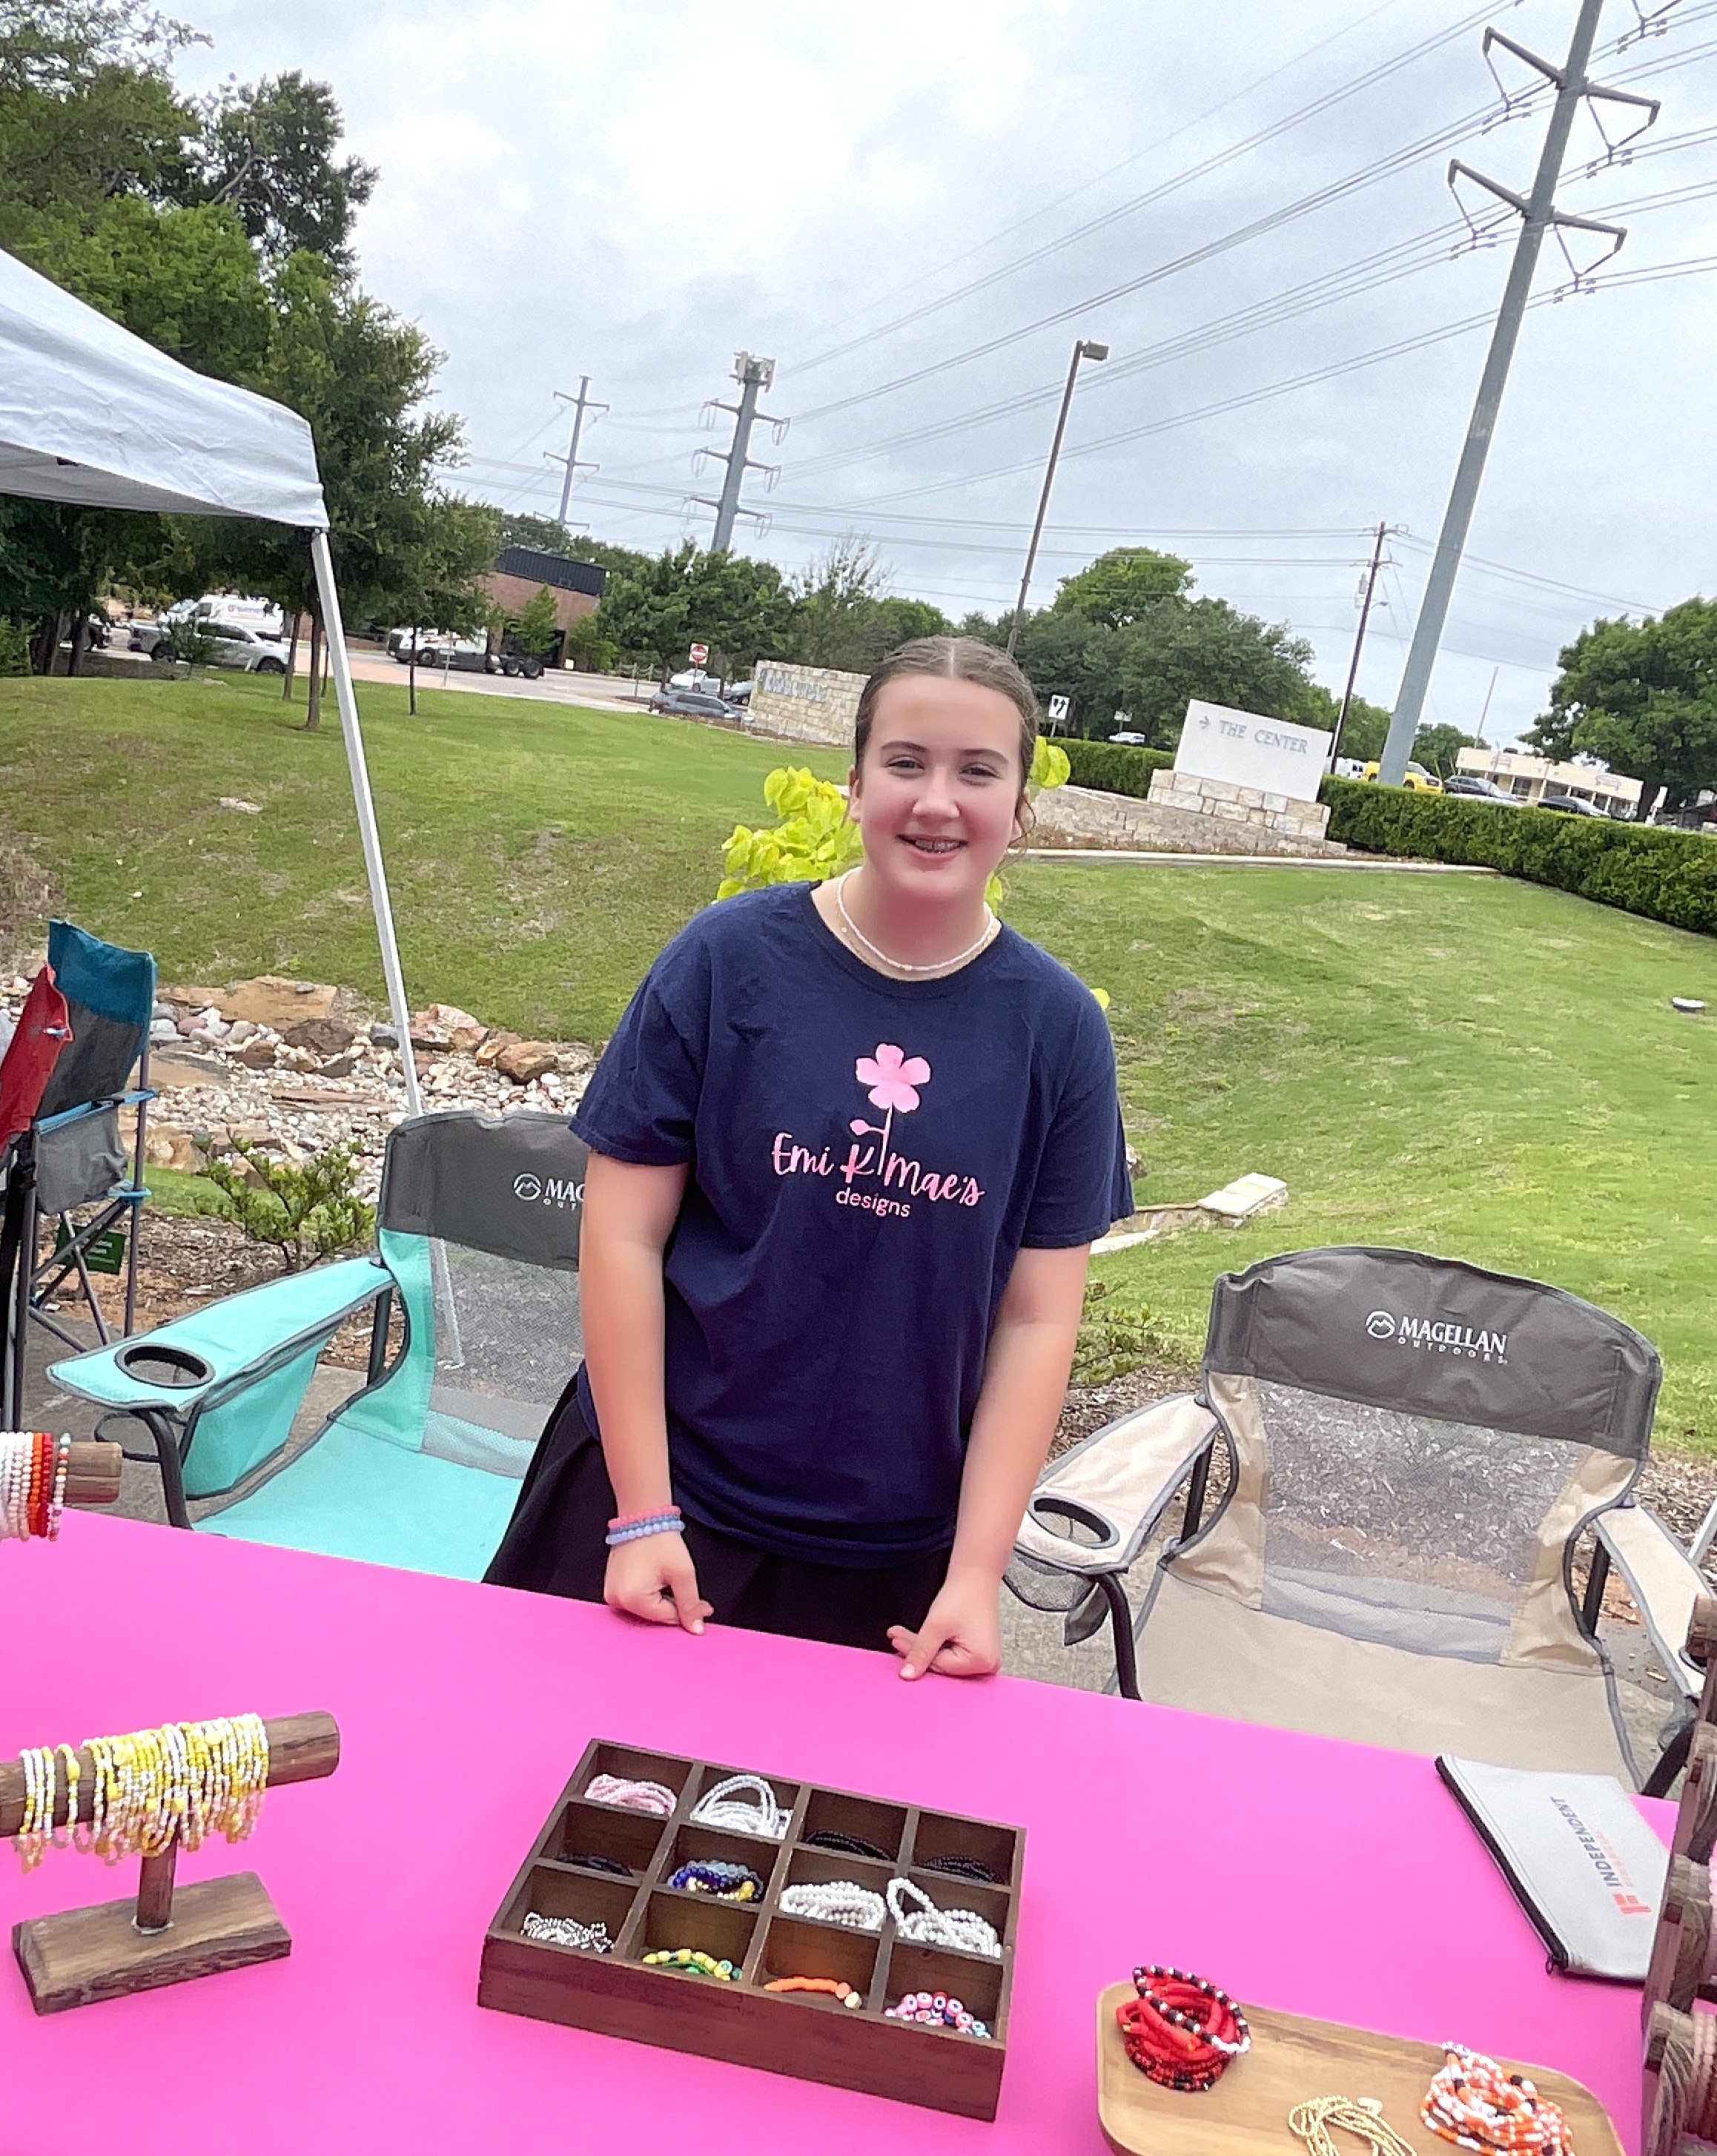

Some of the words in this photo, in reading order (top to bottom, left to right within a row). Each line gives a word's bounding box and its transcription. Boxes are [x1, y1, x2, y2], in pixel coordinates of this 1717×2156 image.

[1220, 720, 1247, 738] THE
[1254, 730, 1308, 754] CENTER
[772, 1132, 834, 1176] Emi
[840, 1143, 875, 1183] K
[884, 1152, 985, 1206] Mae's
[836, 1187, 911, 1217] designs
[1397, 1336, 1504, 1364] OUTDOORS
[1399, 1316, 1506, 1355] MAGELLAN
[1549, 1796, 1622, 1887] INDEPENDENT
